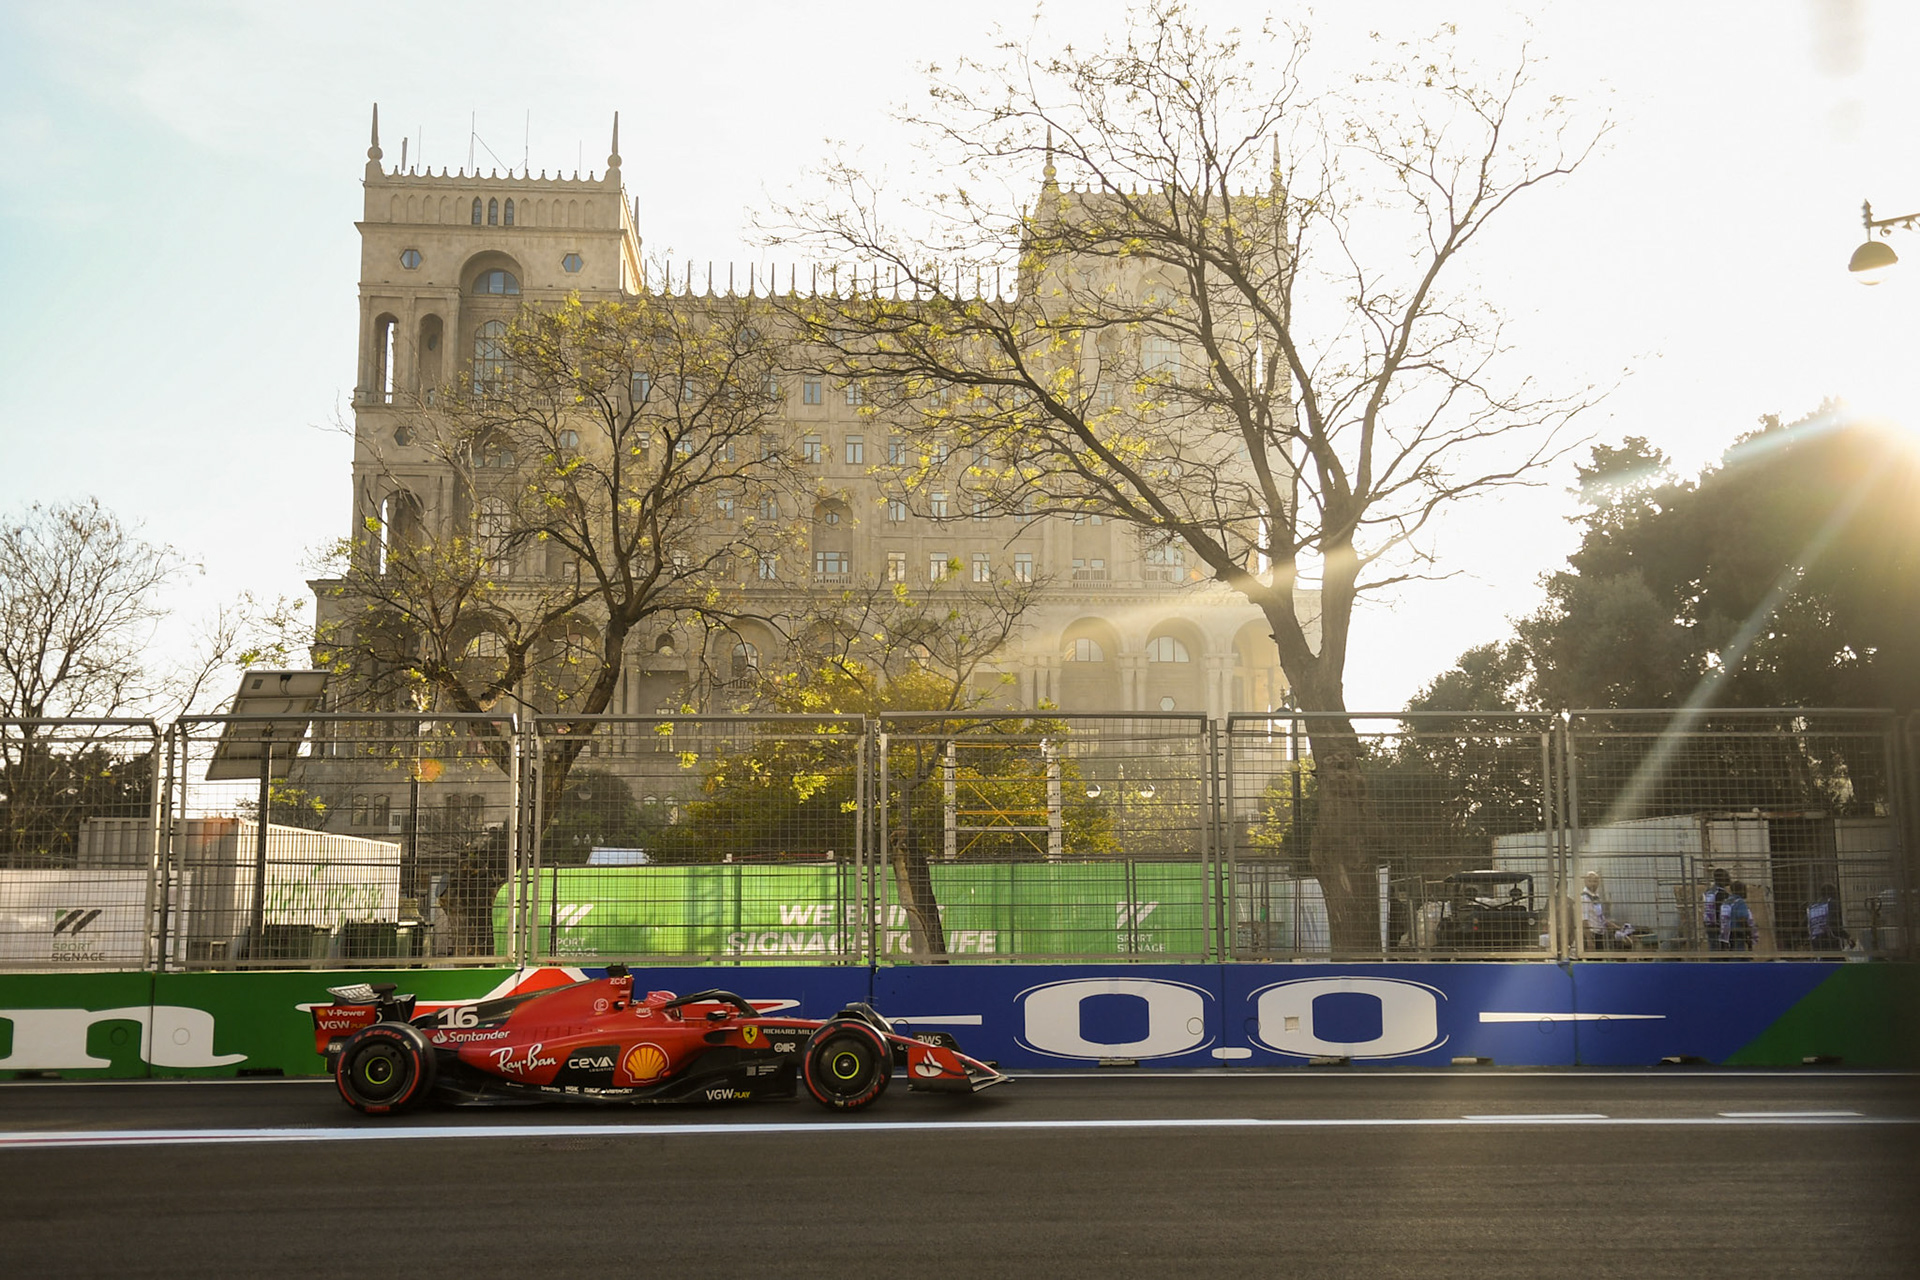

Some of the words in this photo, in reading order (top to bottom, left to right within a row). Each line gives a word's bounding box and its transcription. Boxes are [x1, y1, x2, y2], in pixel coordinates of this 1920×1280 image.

[780, 905, 833, 925] WE
[550, 937, 586, 947] PORT
[946, 931, 998, 953] IFE
[1117, 933, 1153, 943] SPORT
[52, 942, 92, 951] SPORT
[1117, 943, 1166, 952] SIGNAGE
[51, 952, 105, 962] SIGNAGE
[550, 947, 598, 957] IGNAGE
[610, 977, 627, 985] ZCG
[327, 1009, 366, 1017] V-Power
[437, 1006, 479, 1029] 16
[319, 1021, 350, 1030] VGW
[448, 1030, 510, 1043] Santander
[917, 1034, 942, 1045] aws
[706, 1089, 734, 1100] VGW
[733, 1091, 751, 1099] PLAY
